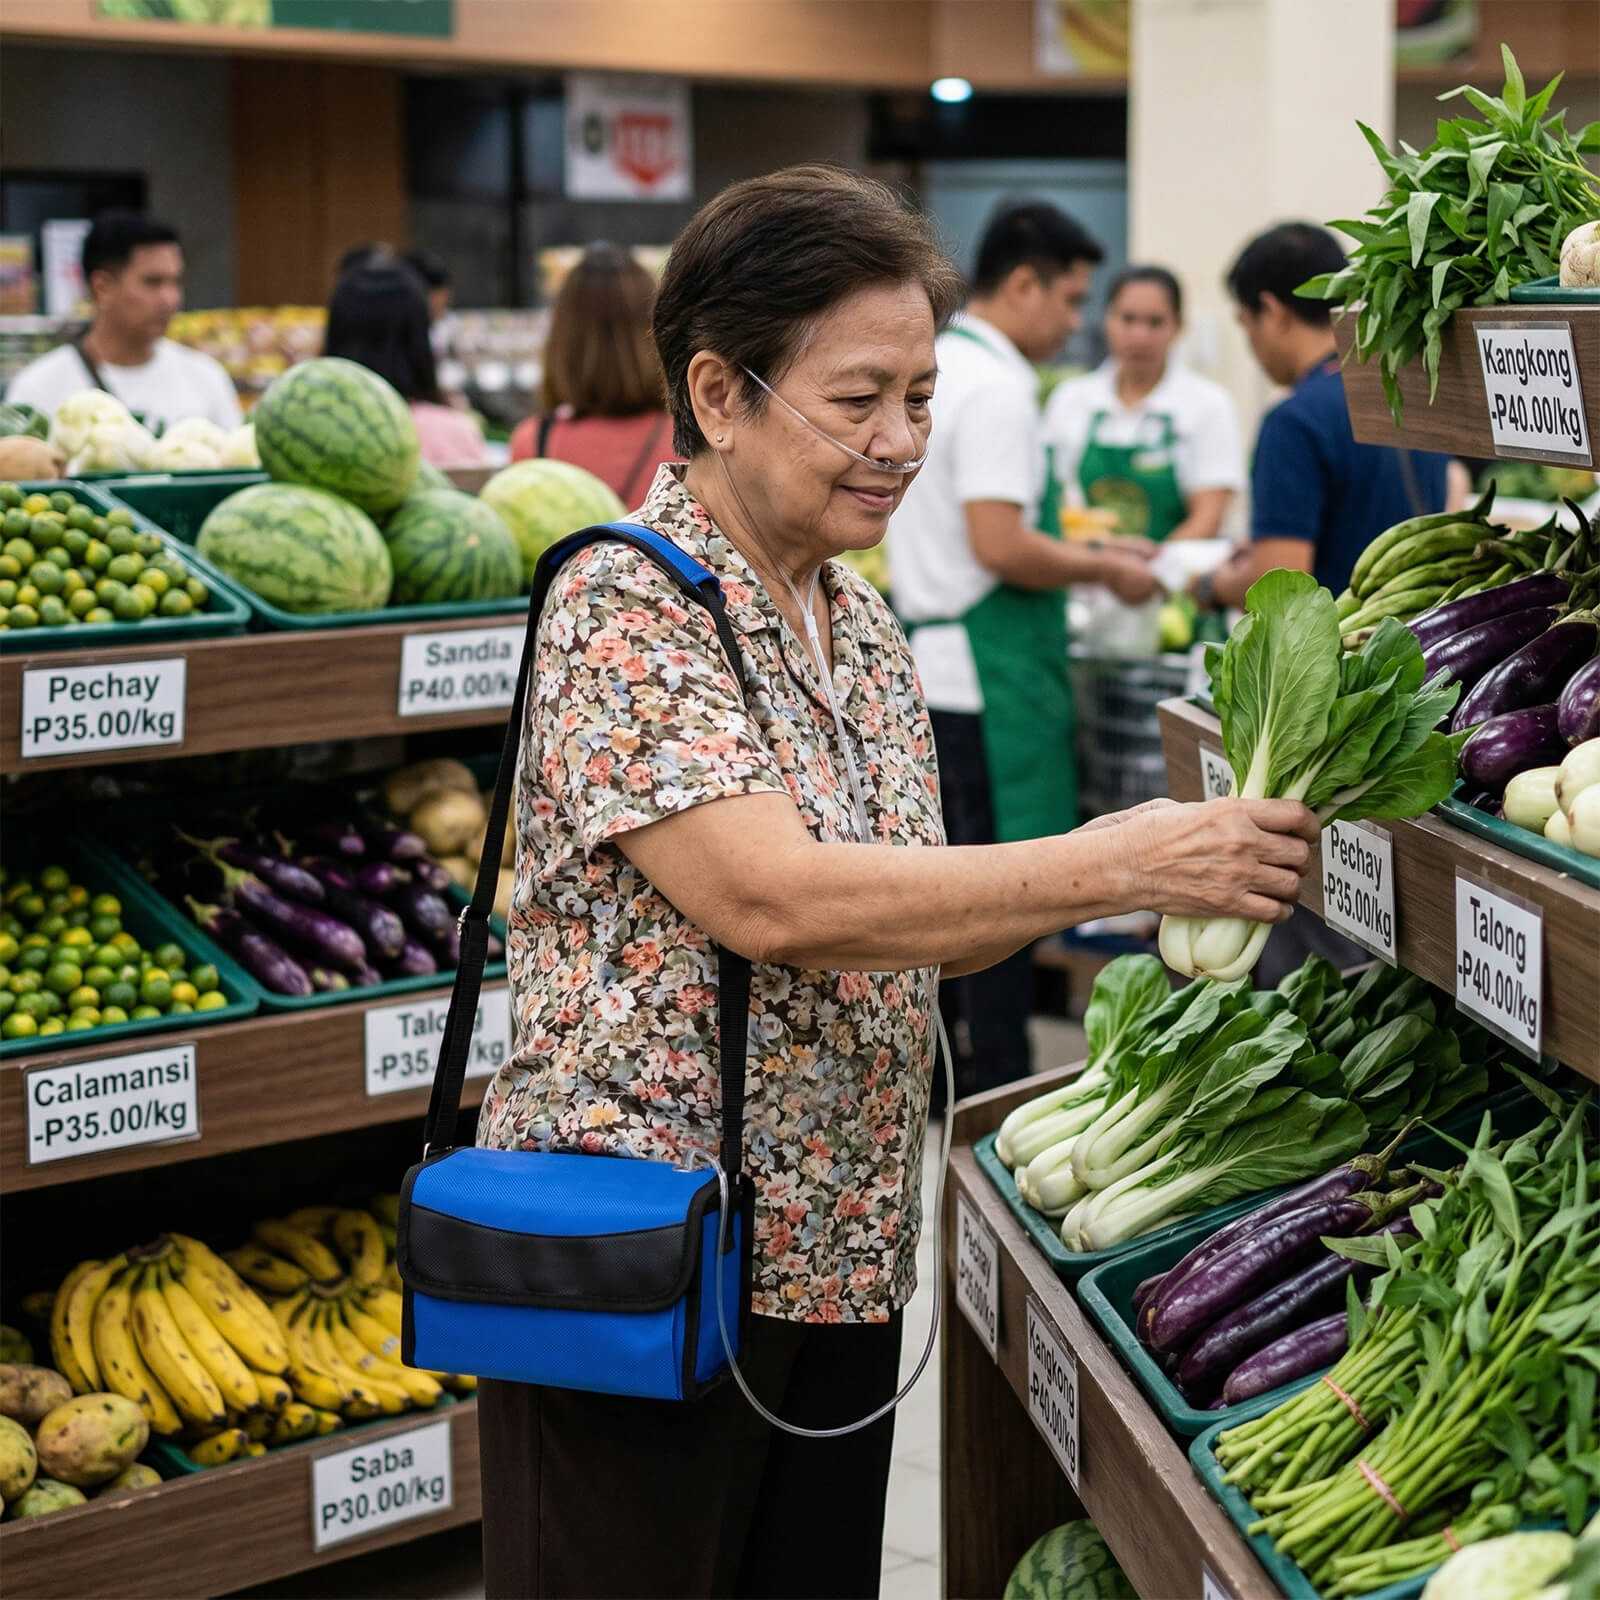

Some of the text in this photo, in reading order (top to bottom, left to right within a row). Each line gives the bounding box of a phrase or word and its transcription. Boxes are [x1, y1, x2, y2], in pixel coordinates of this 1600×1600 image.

[1482, 338, 1572, 388] Kangkong
[1492, 393, 1582, 447] -P40.00/kg
[426, 638, 511, 667] Sandia
[49, 672, 160, 703] Pechay
[25, 708, 175, 744] -P35.00/kg
[1330, 825, 1382, 891] Pechay
[1325, 872, 1391, 948] -P35.00/kg
[1470, 896, 1526, 974] Talong
[1458, 950, 1537, 1039] -P40.00/kg
[34, 1054, 189, 1107] Calamansi
[34, 1100, 187, 1146] -P35.00/kg
[1029, 1316, 1075, 1420] Kangkong
[1030, 1371, 1076, 1473] -P40.00/kg
[351, 1448, 414, 1483] Saba
[322, 1476, 444, 1530] P30.00/kg
